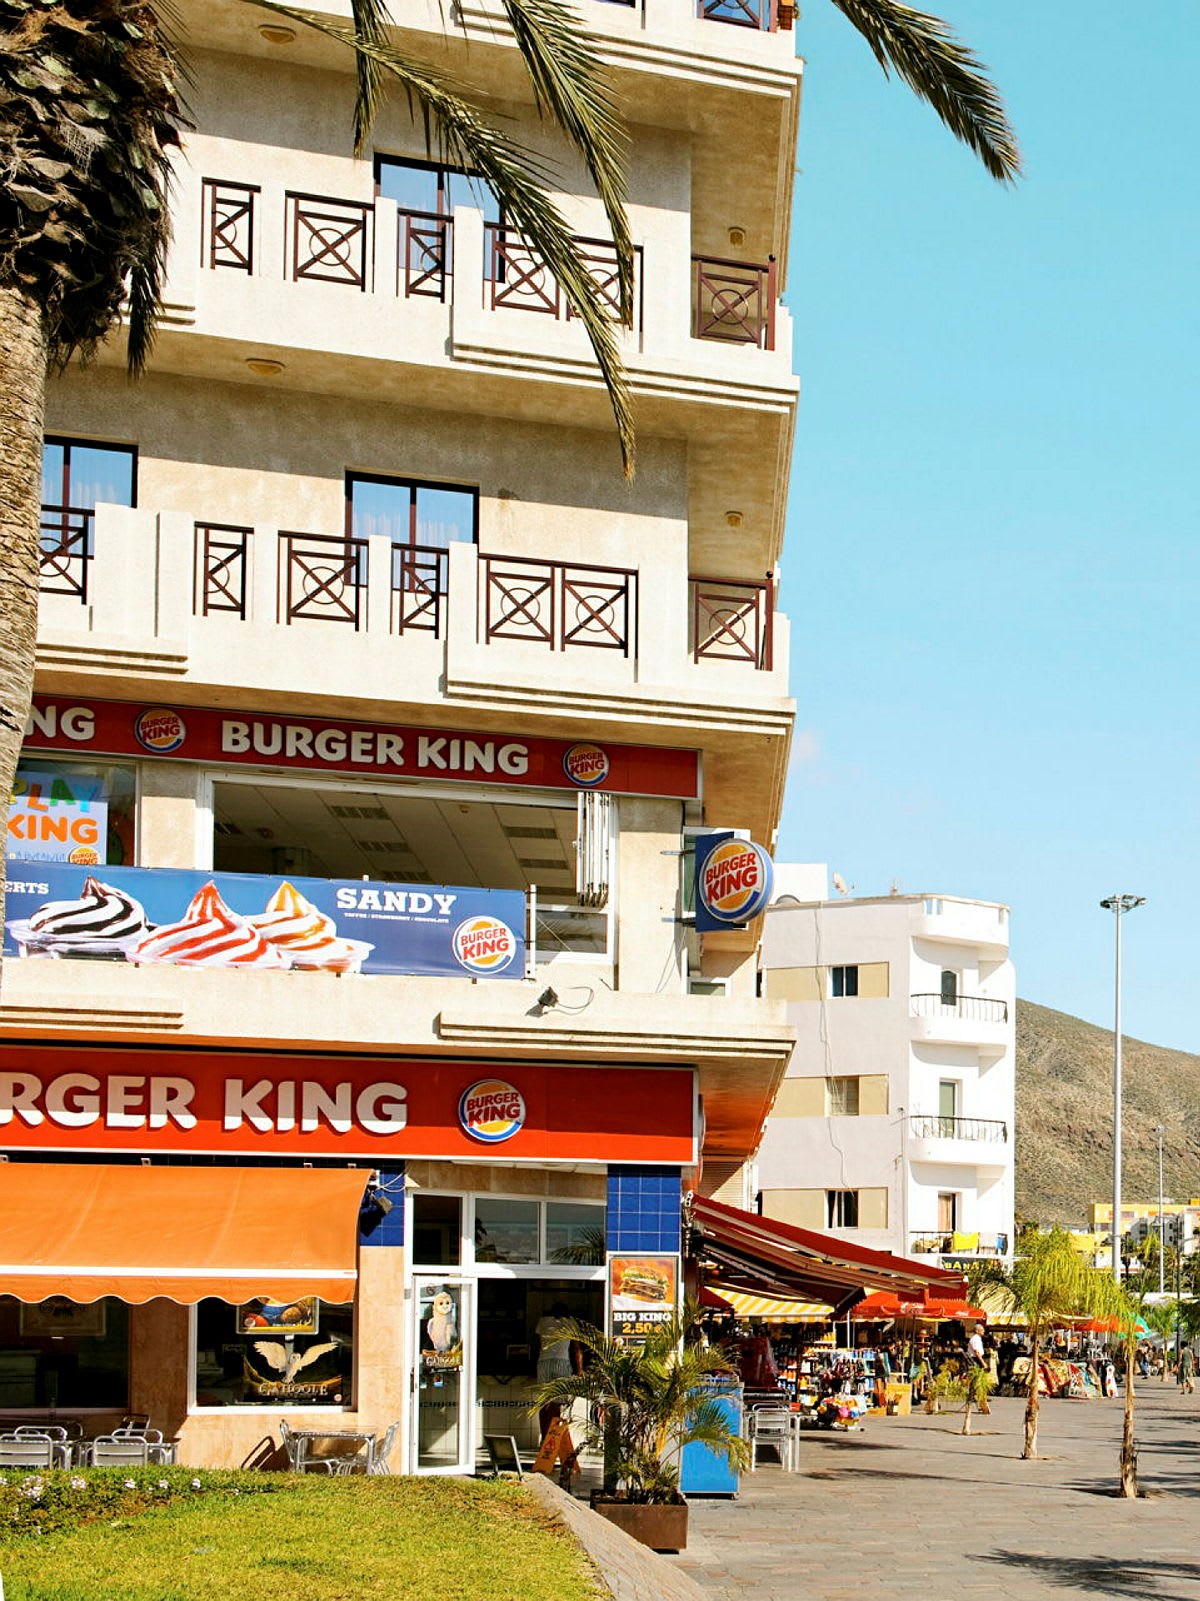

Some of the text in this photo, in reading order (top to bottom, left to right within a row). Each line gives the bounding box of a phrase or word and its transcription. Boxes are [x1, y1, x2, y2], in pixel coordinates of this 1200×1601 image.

[141, 717, 180, 730] BURGER
[142, 724, 181, 742] KING
[222, 720, 529, 775] BURGER KING
[569, 752, 603, 764] BURGER
[570, 760, 604, 775] KING
[9, 779, 98, 812] PLAY
[706, 852, 756, 885] BURGER
[707, 866, 758, 906] KING
[336, 888, 457, 915] SANDY
[461, 927, 507, 946] BURGER
[463, 938, 510, 961] KING
[0, 1071, 409, 1134] RGER KING
[467, 1092, 520, 1111] BURGER
[468, 1103, 521, 1127] KING
[614, 1312, 673, 1322] BIG KING
